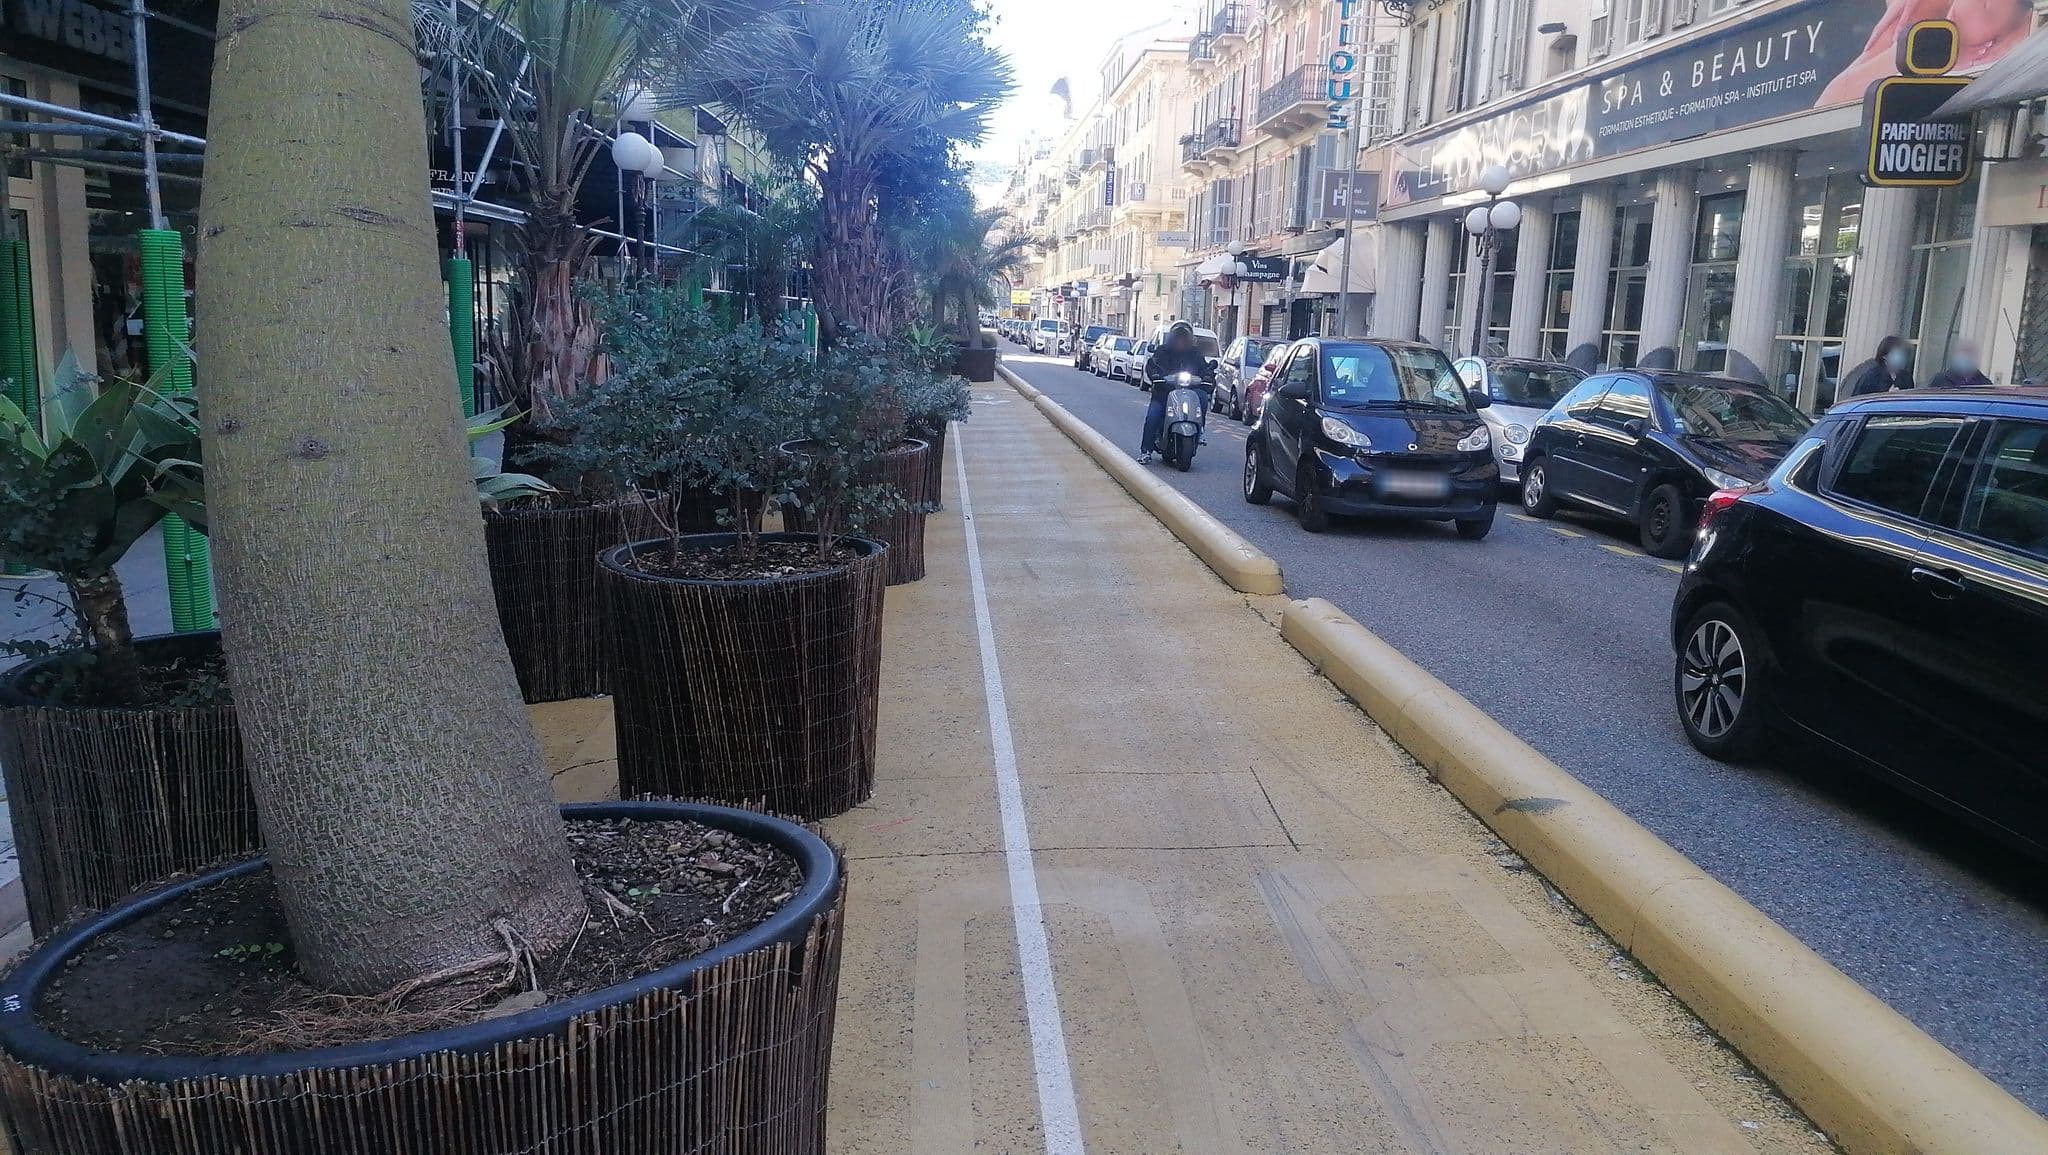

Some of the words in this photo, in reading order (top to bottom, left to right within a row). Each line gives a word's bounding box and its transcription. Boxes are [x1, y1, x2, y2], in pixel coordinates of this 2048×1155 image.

[1602, 80, 1643, 115] SPA
[1660, 70, 1674, 97] &
[1691, 20, 1824, 88] BEAUTY
[1599, 118, 1634, 137] FORMATION
[1635, 107, 1675, 129] ESTHETIQUE
[1680, 93, 1723, 116] FORMATION
[1724, 90, 1740, 105] SPA
[1746, 77, 1785, 99] INSTITUT
[1786, 74, 1798, 89] ET
[1799, 68, 1817, 85] SPA
[1879, 143, 1963, 172] NOGIER
[1244, 271, 1281, 280] ampagne
[1252, 259, 1268, 269] Vins
